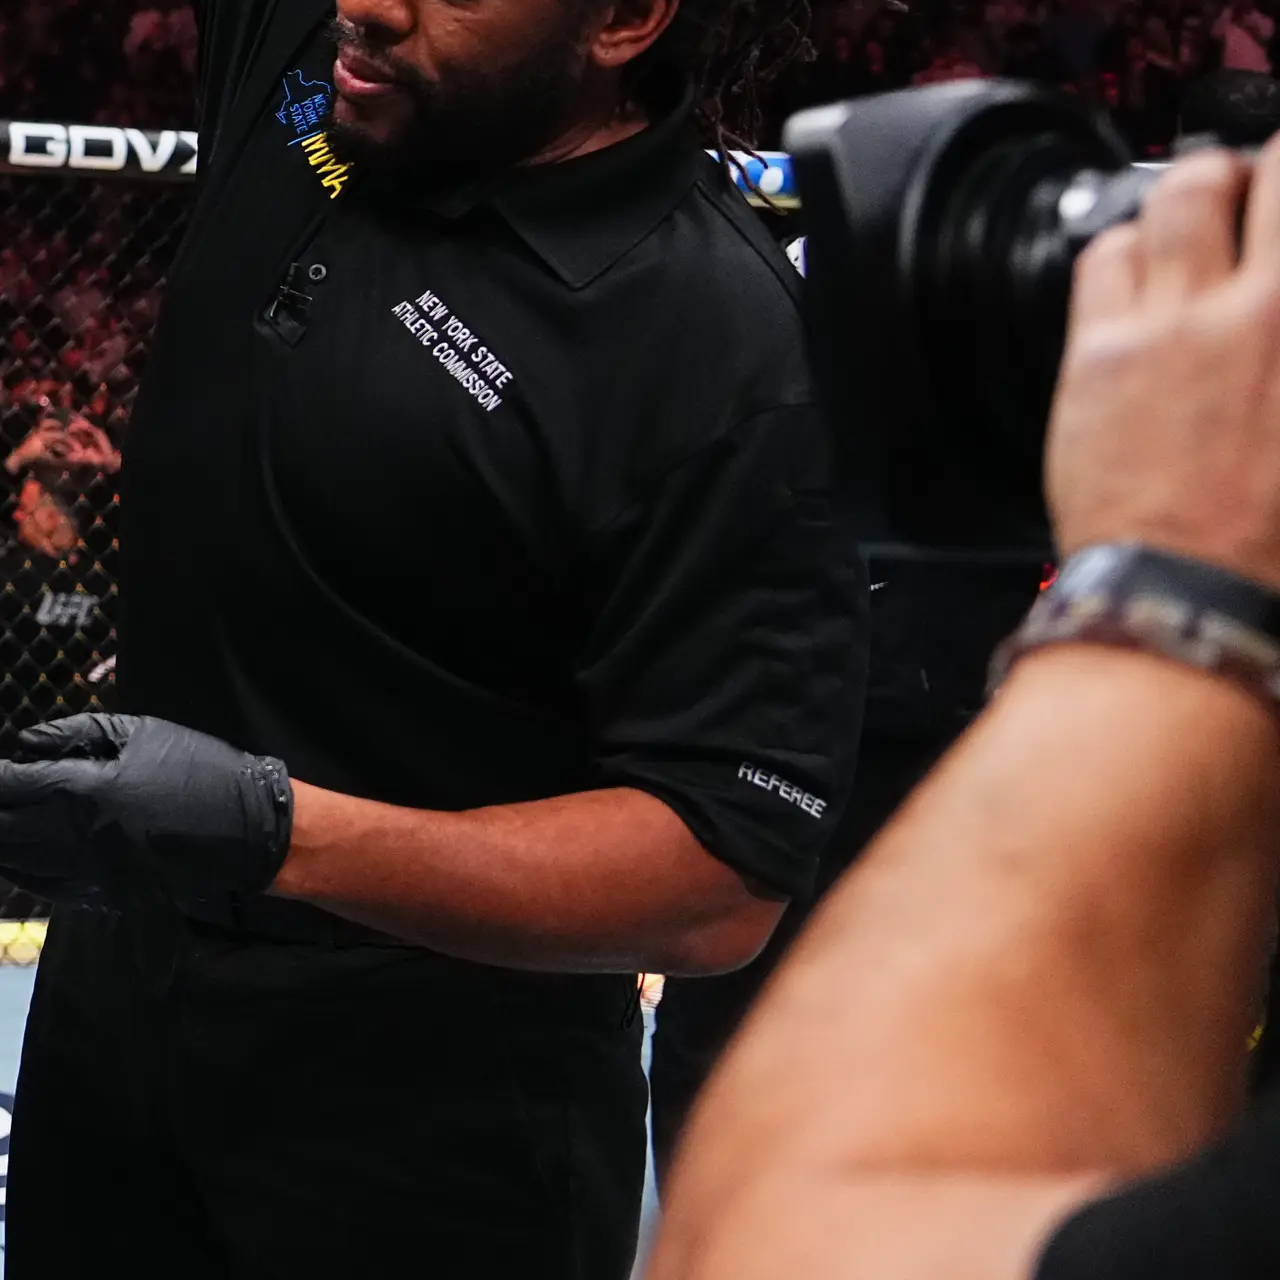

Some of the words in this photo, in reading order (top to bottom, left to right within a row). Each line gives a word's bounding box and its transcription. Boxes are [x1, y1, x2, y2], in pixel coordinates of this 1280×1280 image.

[289, 103, 309, 135] STATE
[301, 97, 320, 127] YORK
[391, 300, 439, 346] ATHLETIC
[432, 342, 503, 412] COMMISSION
[415, 289, 449, 321] NEW
[441, 315, 478, 352] YORK
[471, 346, 514, 389] STATE
[738, 761, 828, 820] REFEREE
